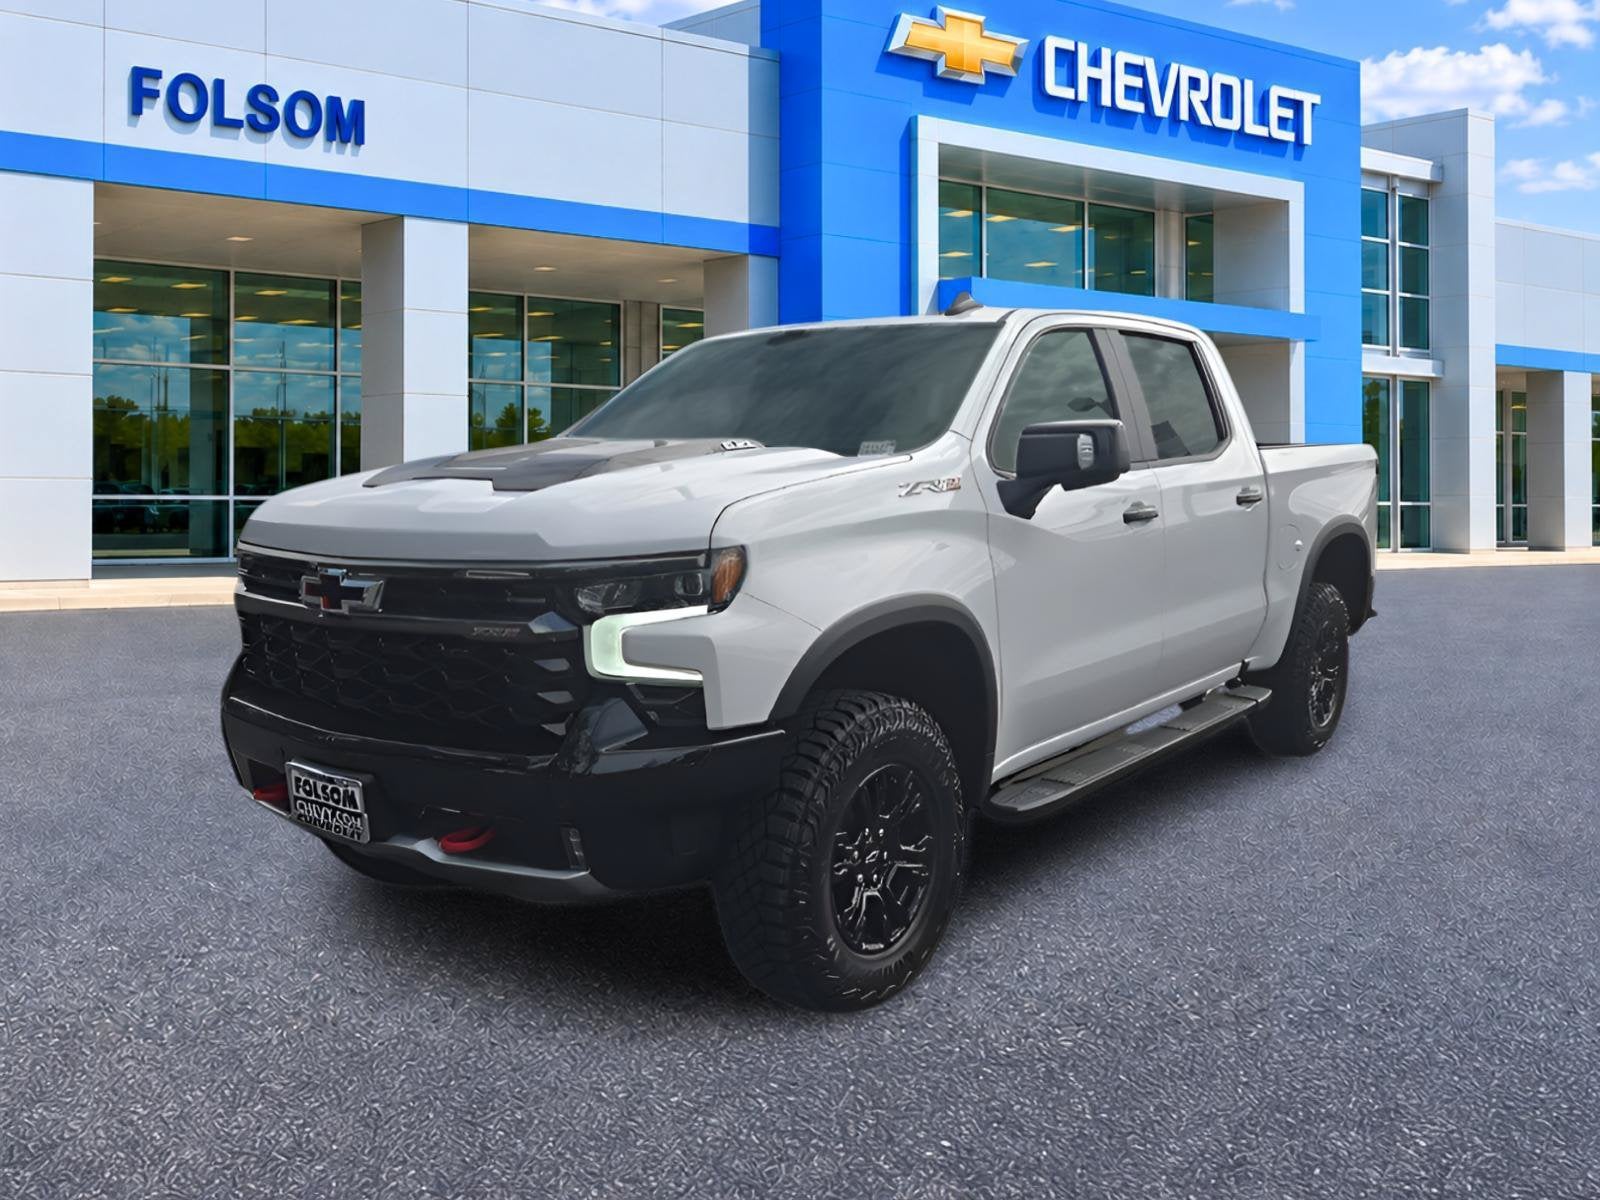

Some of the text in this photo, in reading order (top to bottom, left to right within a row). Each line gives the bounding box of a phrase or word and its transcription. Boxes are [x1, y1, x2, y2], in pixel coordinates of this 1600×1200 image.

[131, 65, 365, 146] FOLSOM
[1044, 35, 1321, 145] CHEVROLET
[294, 776, 360, 811] FOLSOM
